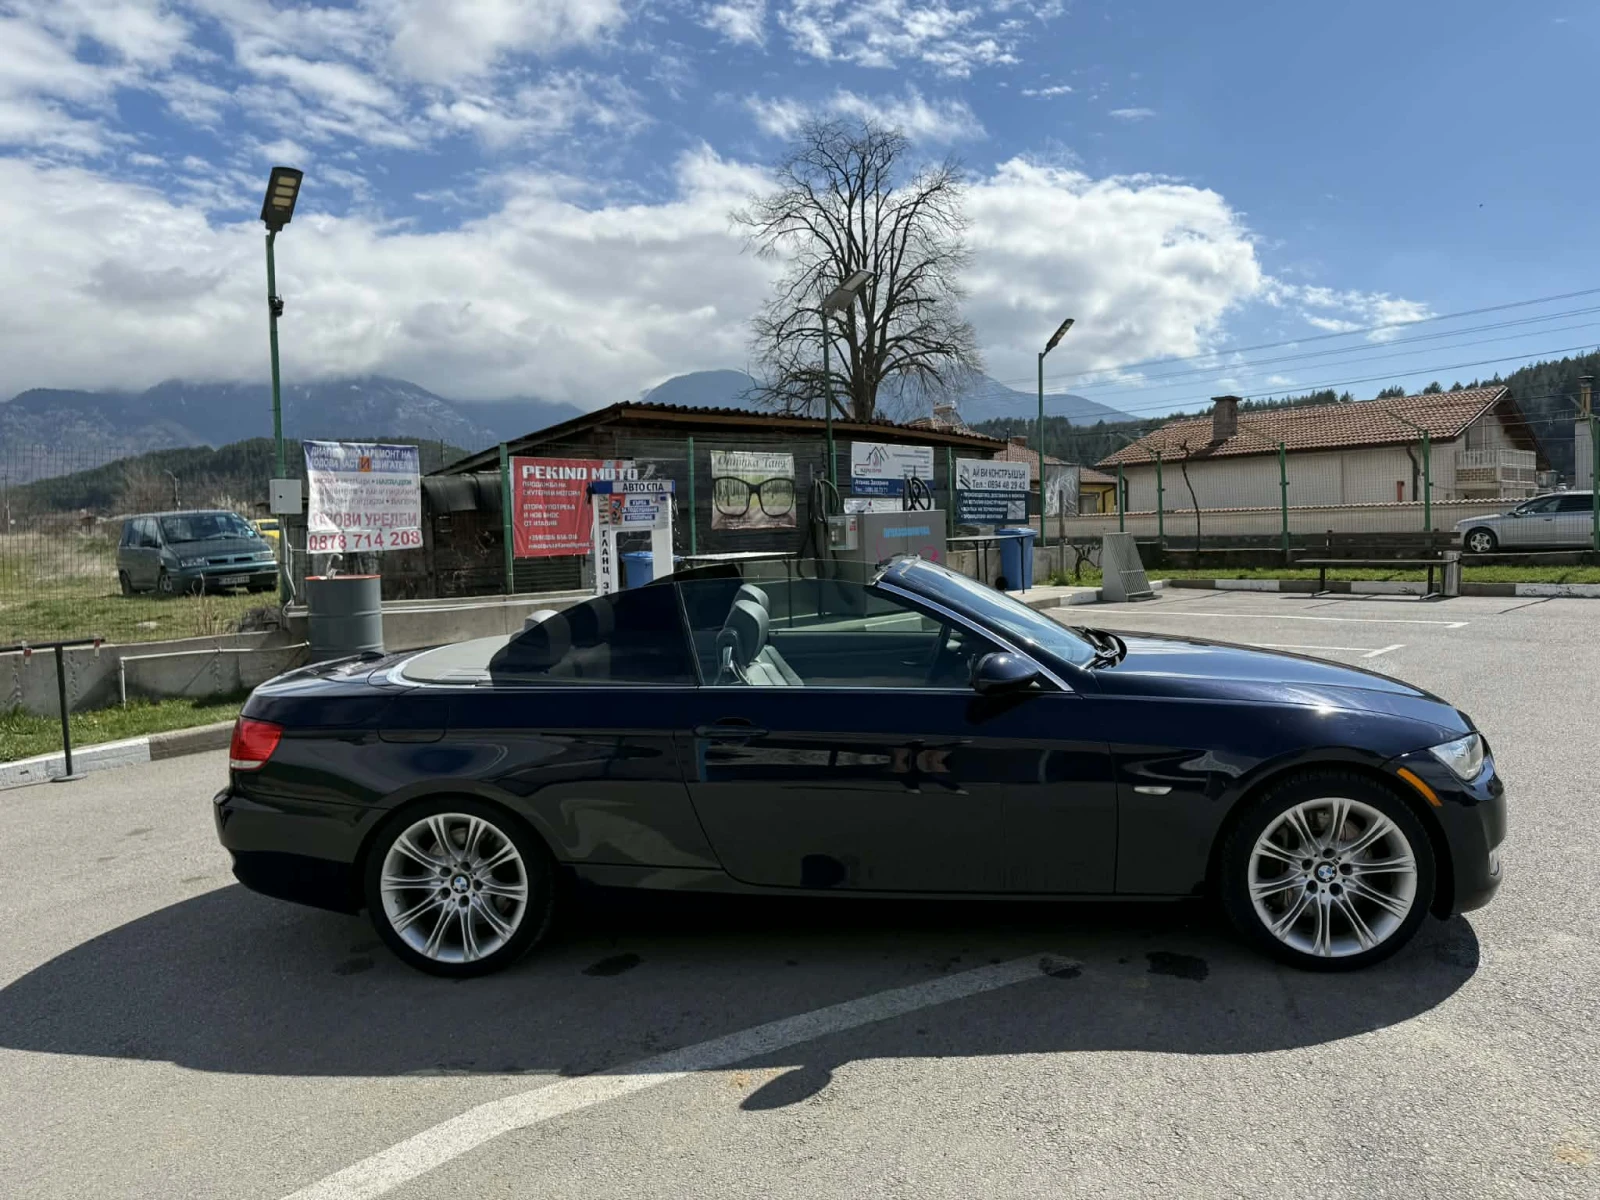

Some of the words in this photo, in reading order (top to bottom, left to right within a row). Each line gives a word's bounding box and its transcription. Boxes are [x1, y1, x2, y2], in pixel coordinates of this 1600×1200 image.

[402, 450, 411, 458] НА
[310, 457, 338, 469] ОДОВА
[360, 457, 371, 471] И
[591, 467, 639, 481] MOTO
[622, 482, 645, 491] АВТО
[646, 482, 664, 491] СПА
[364, 512, 417, 528] УРЕДБИ
[309, 534, 347, 551] 0878
[353, 532, 384, 549] 714
[390, 530, 420, 546] 208
[602, 530, 610, 575] ГЛАНЦ
